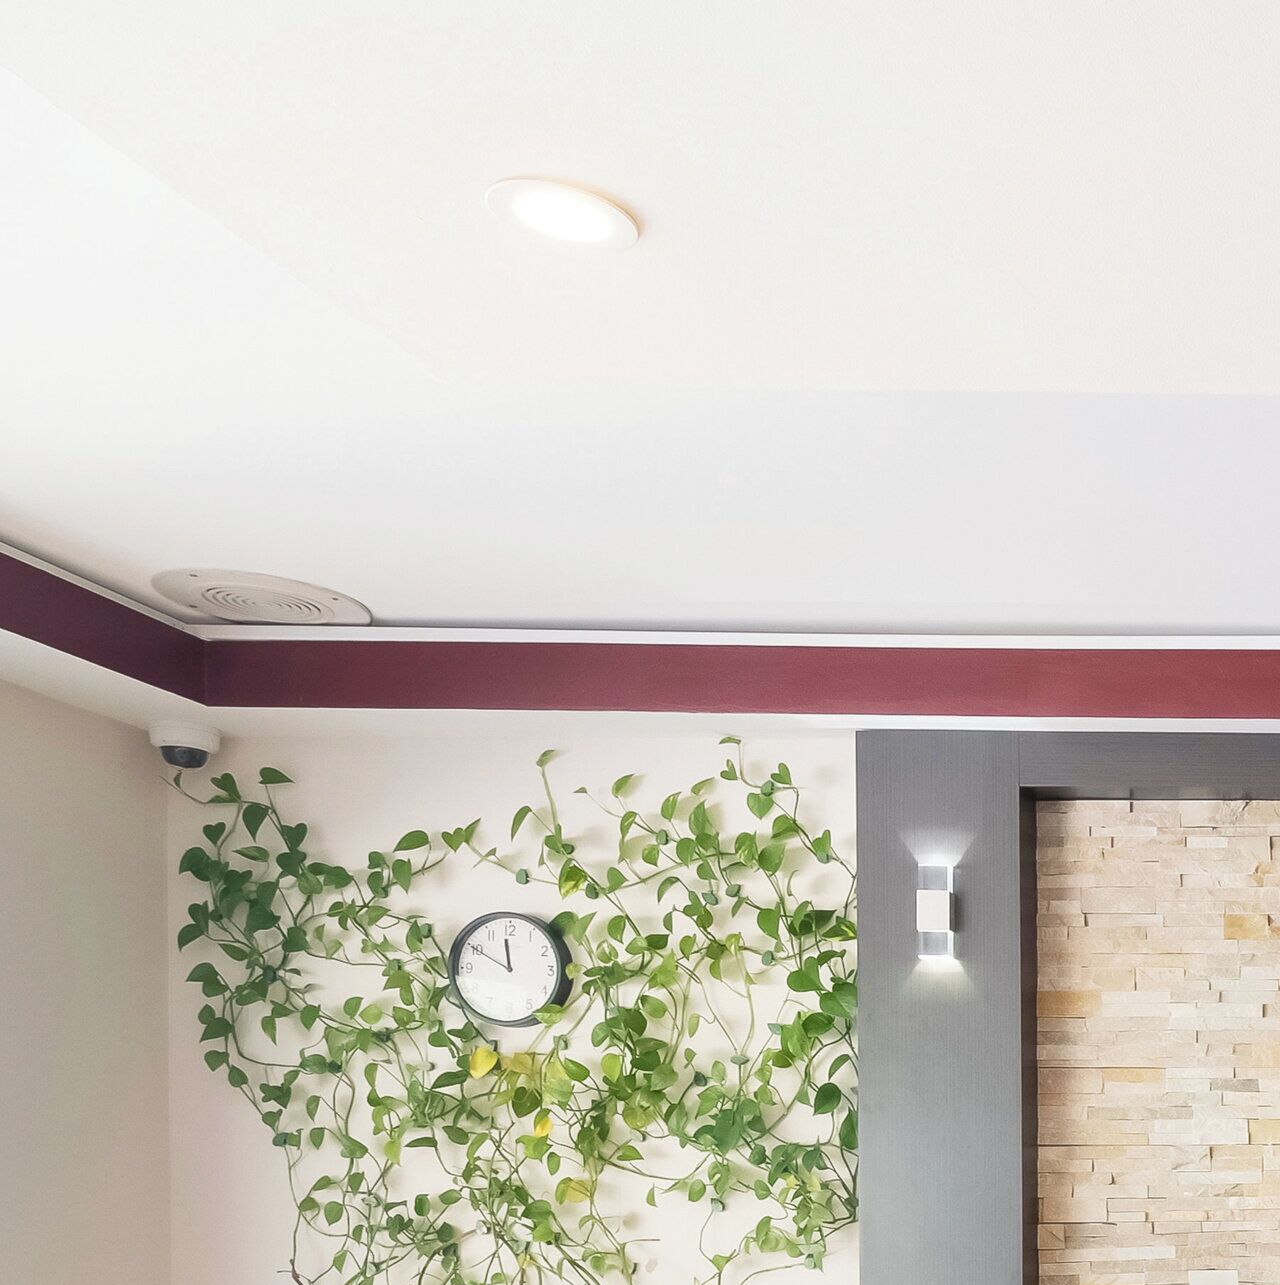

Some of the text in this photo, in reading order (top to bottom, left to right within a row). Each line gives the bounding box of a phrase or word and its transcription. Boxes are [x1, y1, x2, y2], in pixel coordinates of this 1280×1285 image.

[505, 925, 516, 936] 12
[541, 946, 548, 957] 2
[465, 963, 473, 973] 9
[547, 965, 554, 976] 3
